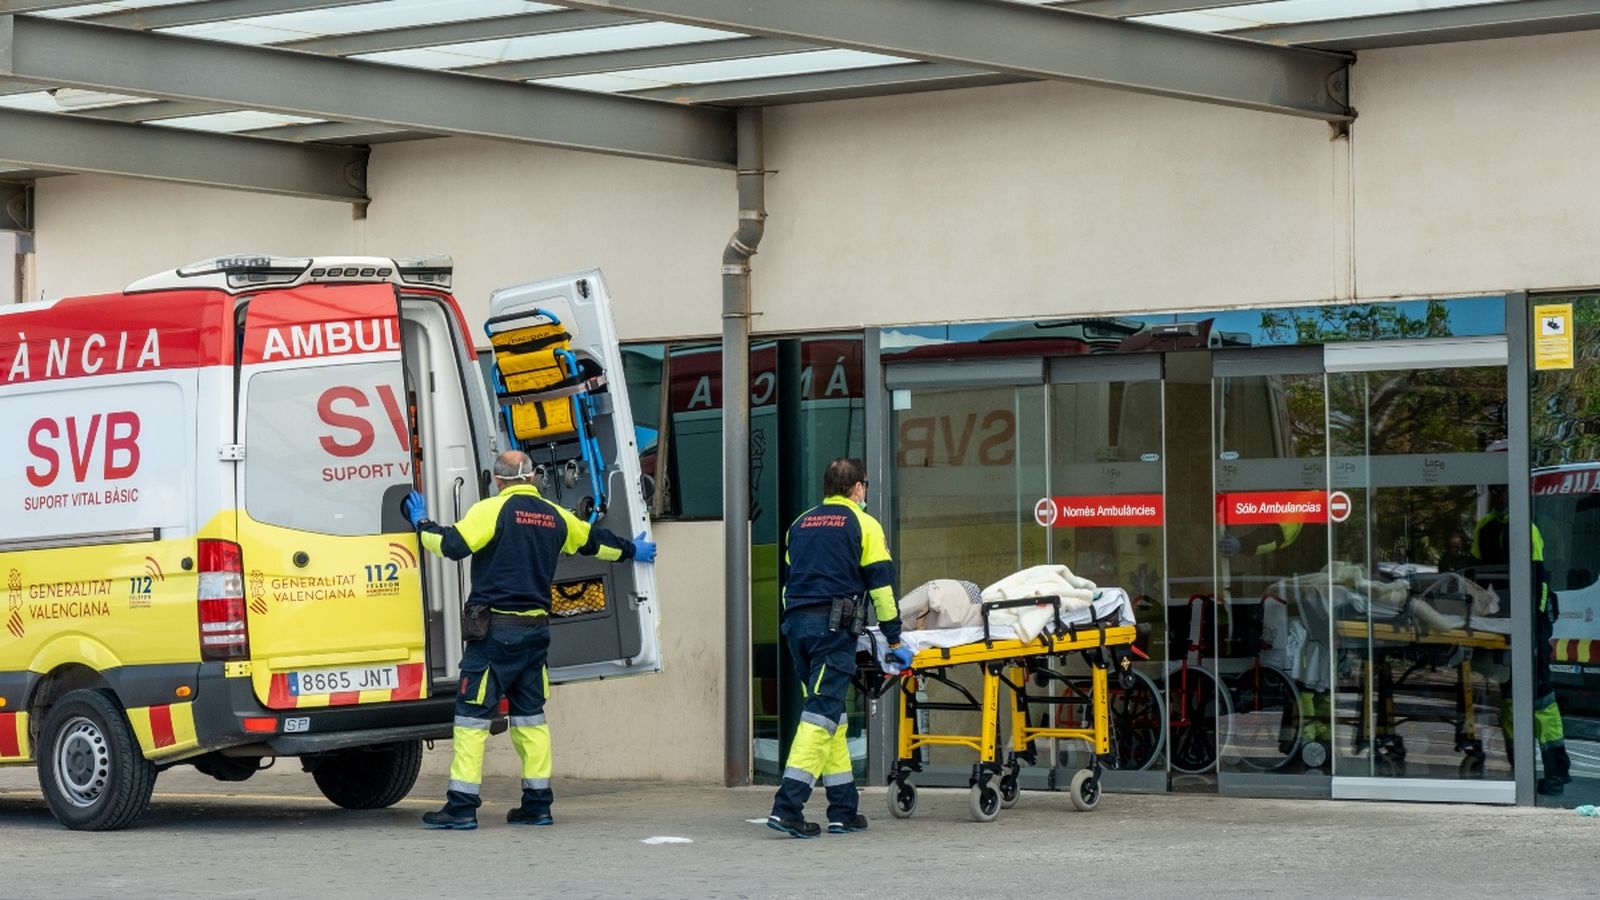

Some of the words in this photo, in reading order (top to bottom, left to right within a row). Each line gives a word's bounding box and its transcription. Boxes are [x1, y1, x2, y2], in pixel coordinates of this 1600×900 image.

[262, 319, 401, 360] AMBUL
[8, 328, 161, 381] ÀNCIA
[26, 411, 141, 487] SVB
[322, 463, 393, 482] SUPORT
[25, 494, 69, 511] SUPORT
[72, 491, 101, 507] VITAL
[104, 487, 139, 504] BÀSIC
[1235, 502, 1257, 515] Sólo
[1258, 501, 1322, 514] Ambulancias
[803, 514, 848, 523] TRANSPORT
[1063, 505, 1095, 518] Només
[515, 517, 556, 528] SANITARI
[800, 520, 845, 528] SANITARI
[364, 562, 399, 583] 112
[29, 578, 113, 599] GENERALITAT
[130, 575, 152, 594] 112
[271, 574, 356, 591] GENERALITAT
[273, 588, 356, 603] VALENCIANA
[29, 604, 110, 621] VALENCIANA
[303, 671, 350, 691] 8665
[359, 668, 392, 687] JNT
[286, 719, 308, 731] SP
